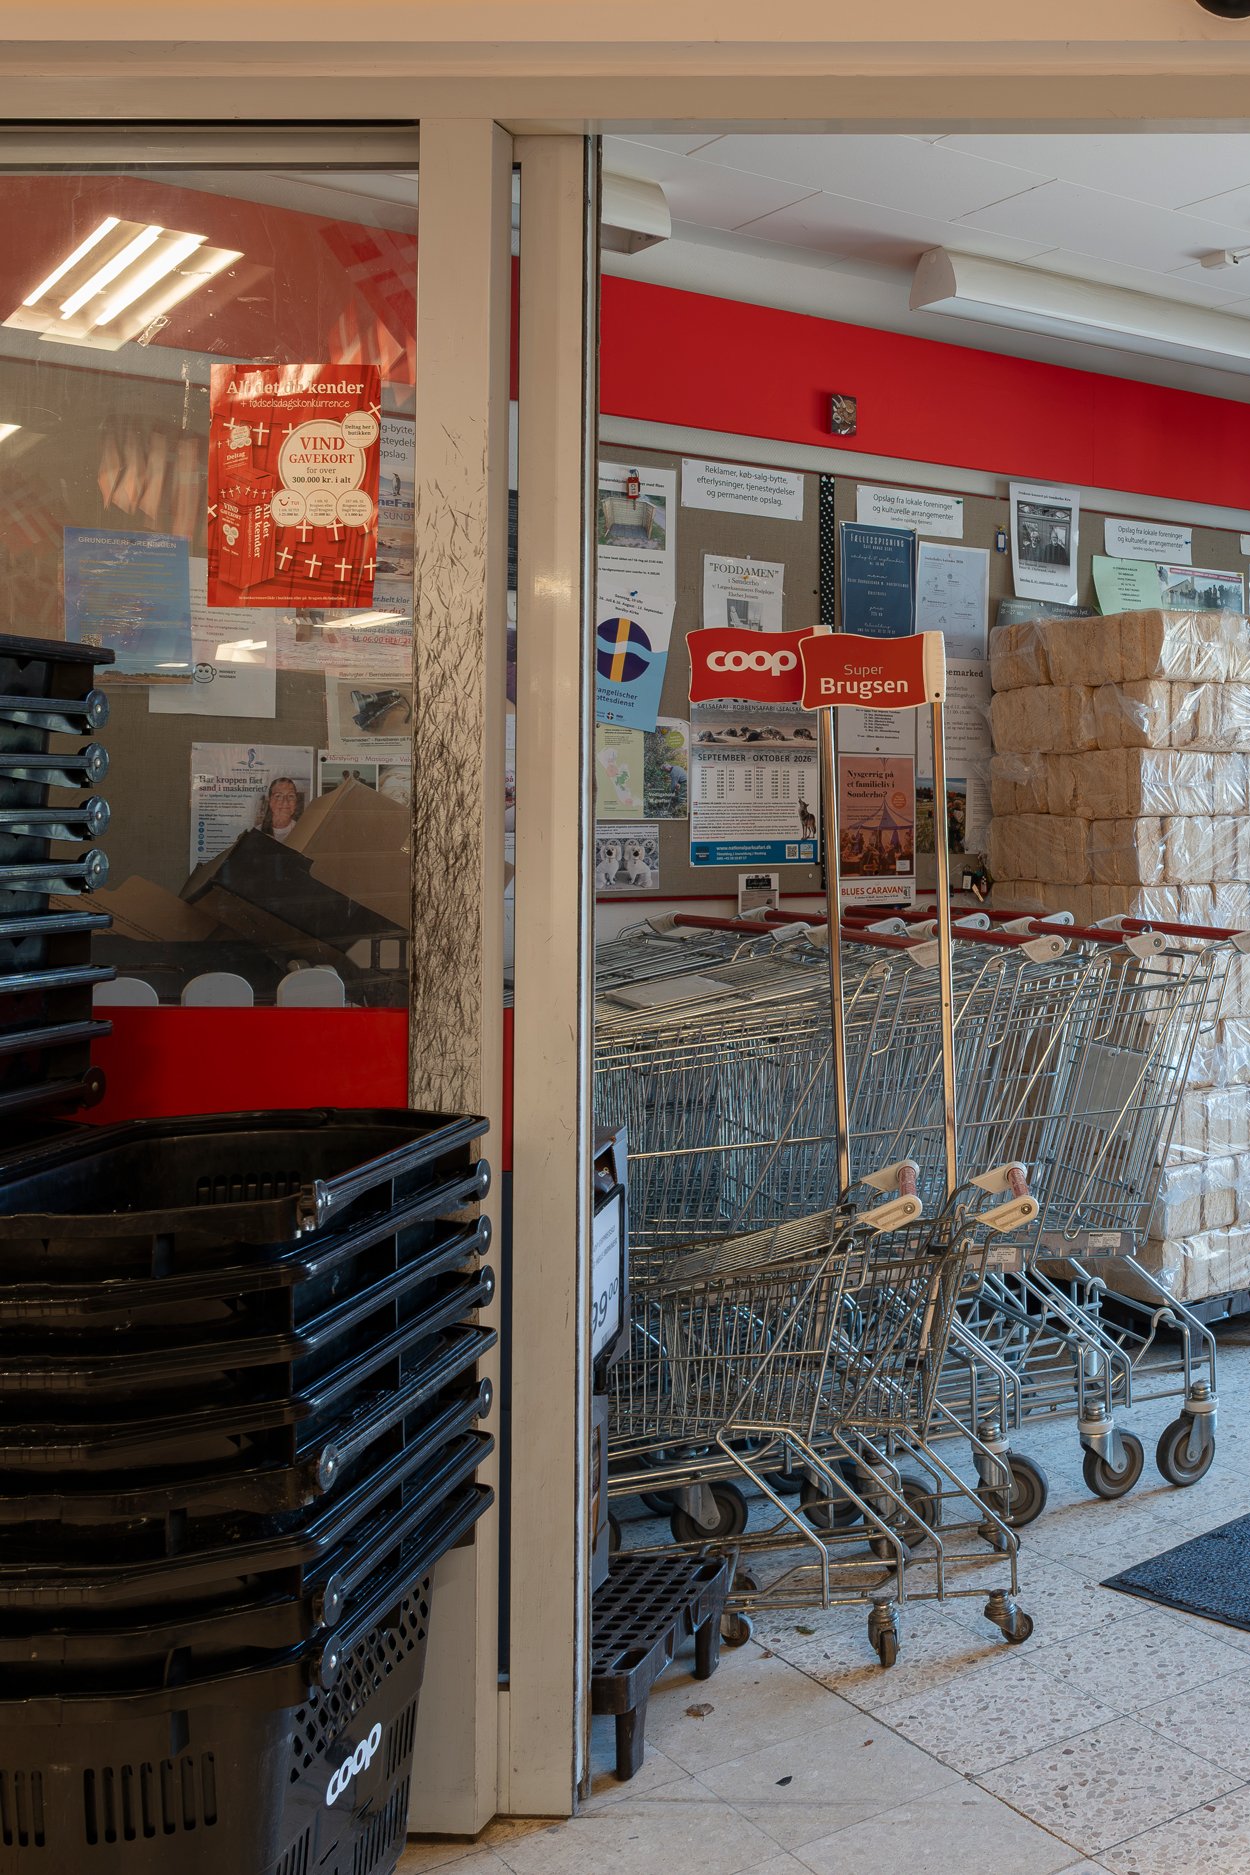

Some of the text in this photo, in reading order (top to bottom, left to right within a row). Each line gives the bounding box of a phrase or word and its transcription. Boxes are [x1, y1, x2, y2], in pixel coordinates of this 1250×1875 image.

[257, 381, 281, 394] det
[308, 381, 364, 394] kender
[249, 399, 351, 411] fødselsdagskonkurrence
[300, 437, 345, 450] VIND
[380, 436, 416, 448] steydels
[226, 452, 246, 461] Deltag
[289, 453, 355, 464] GAVEKORT
[306, 466, 318, 474] for
[705, 465, 788, 485] Reklamer, køb-salg-bytte,
[292, 476, 321, 484] 300.000
[322, 476, 334, 484] kr.
[340, 476, 351, 484] alt
[697, 476, 796, 497] efterlysninger, tjenesteydelser
[706, 489, 783, 506] og permanente opslag.
[873, 494, 953, 510] Opslag fra lokale foreninger
[223, 503, 239, 513] VIND
[881, 505, 911, 516] kulturelle
[911, 510, 954, 521] arrangementer
[254, 505, 263, 558] du kender
[262, 521, 270, 539] det
[1118, 525, 1135, 535] Opslag
[1158, 530, 1184, 540] foreninger
[850, 533, 905, 548] FÆLLESSPISNING
[1148, 540, 1184, 549] arrangementer
[706, 650, 797, 676] coop
[844, 664, 884, 678] Super
[597, 687, 638, 700] angelischer
[820, 677, 909, 699] Brugsen
[596, 694, 635, 708] ottesdienst
[698, 753, 812, 763] SEPTEMBER OKTOBER 2026
[216, 776, 248, 785] kroppen
[847, 770, 894, 780] Nysgerrig på
[199, 784, 217, 792] sand
[223, 785, 268, 793] maskineriet?
[855, 780, 890, 788] familieliv
[841, 886, 904, 896] BLUES CARAVAN
[326, 1722, 382, 1806] coop
